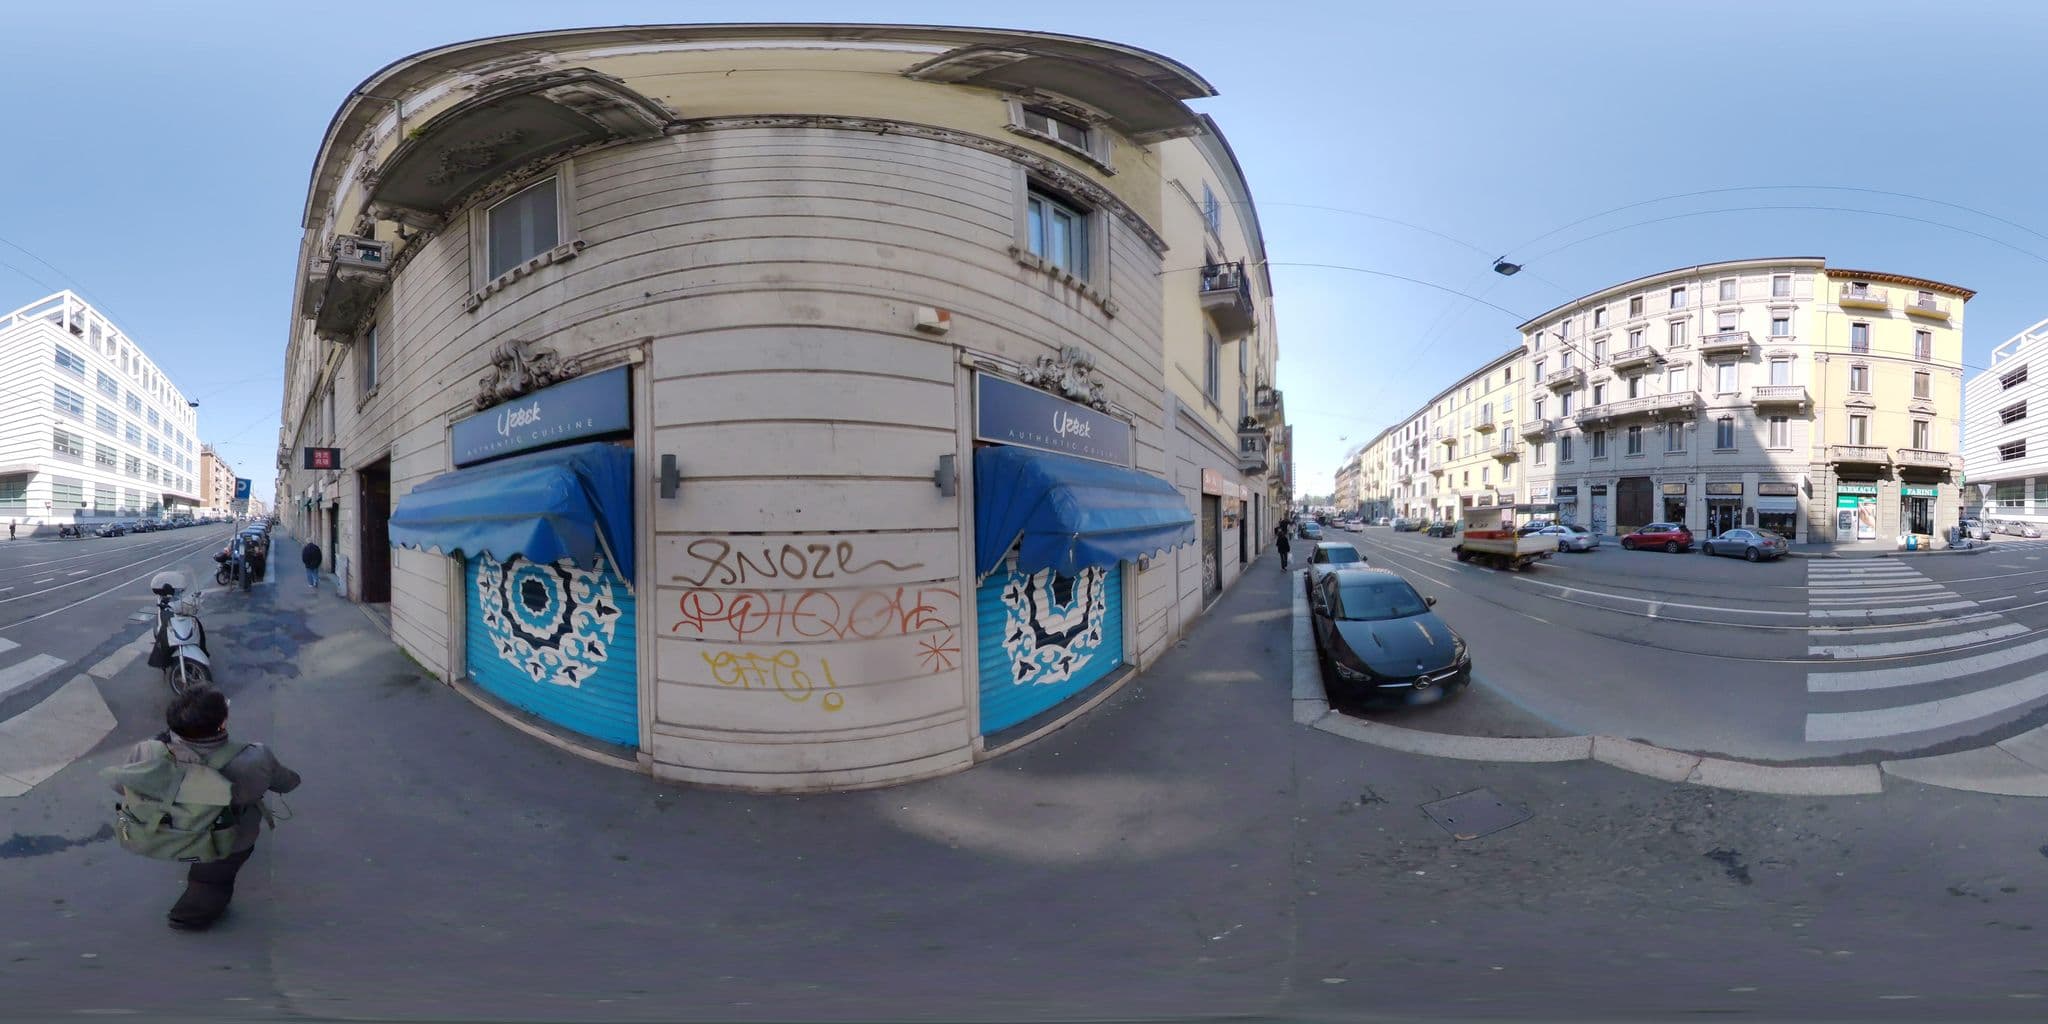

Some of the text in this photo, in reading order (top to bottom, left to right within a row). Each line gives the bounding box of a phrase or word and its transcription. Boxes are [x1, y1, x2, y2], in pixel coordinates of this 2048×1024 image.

[531, 418, 593, 440] CUISINE
[237, 480, 247, 497] P
[1838, 485, 1877, 494] FARMACIA
[1907, 488, 1933, 496] FARINI
